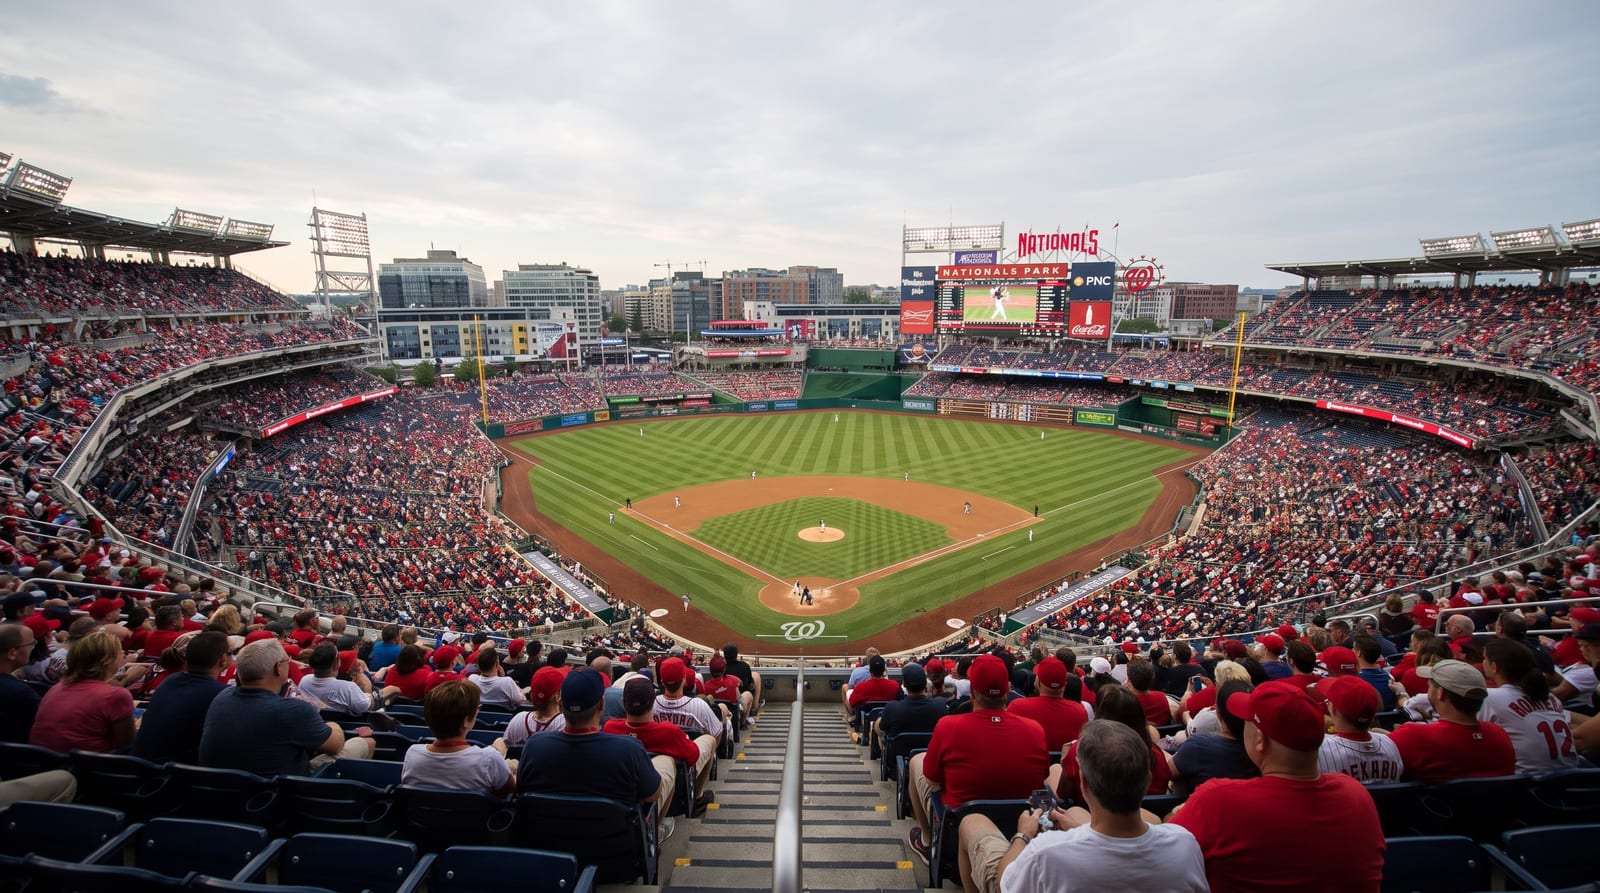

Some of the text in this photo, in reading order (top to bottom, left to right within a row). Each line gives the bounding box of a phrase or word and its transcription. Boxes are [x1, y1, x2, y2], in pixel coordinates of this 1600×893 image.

[1018, 230, 1098, 258] NATIONALS
[943, 266, 1060, 277] NATIONALS PARK
[1086, 276, 1111, 286] PNC
[1537, 719, 1573, 760] 12
